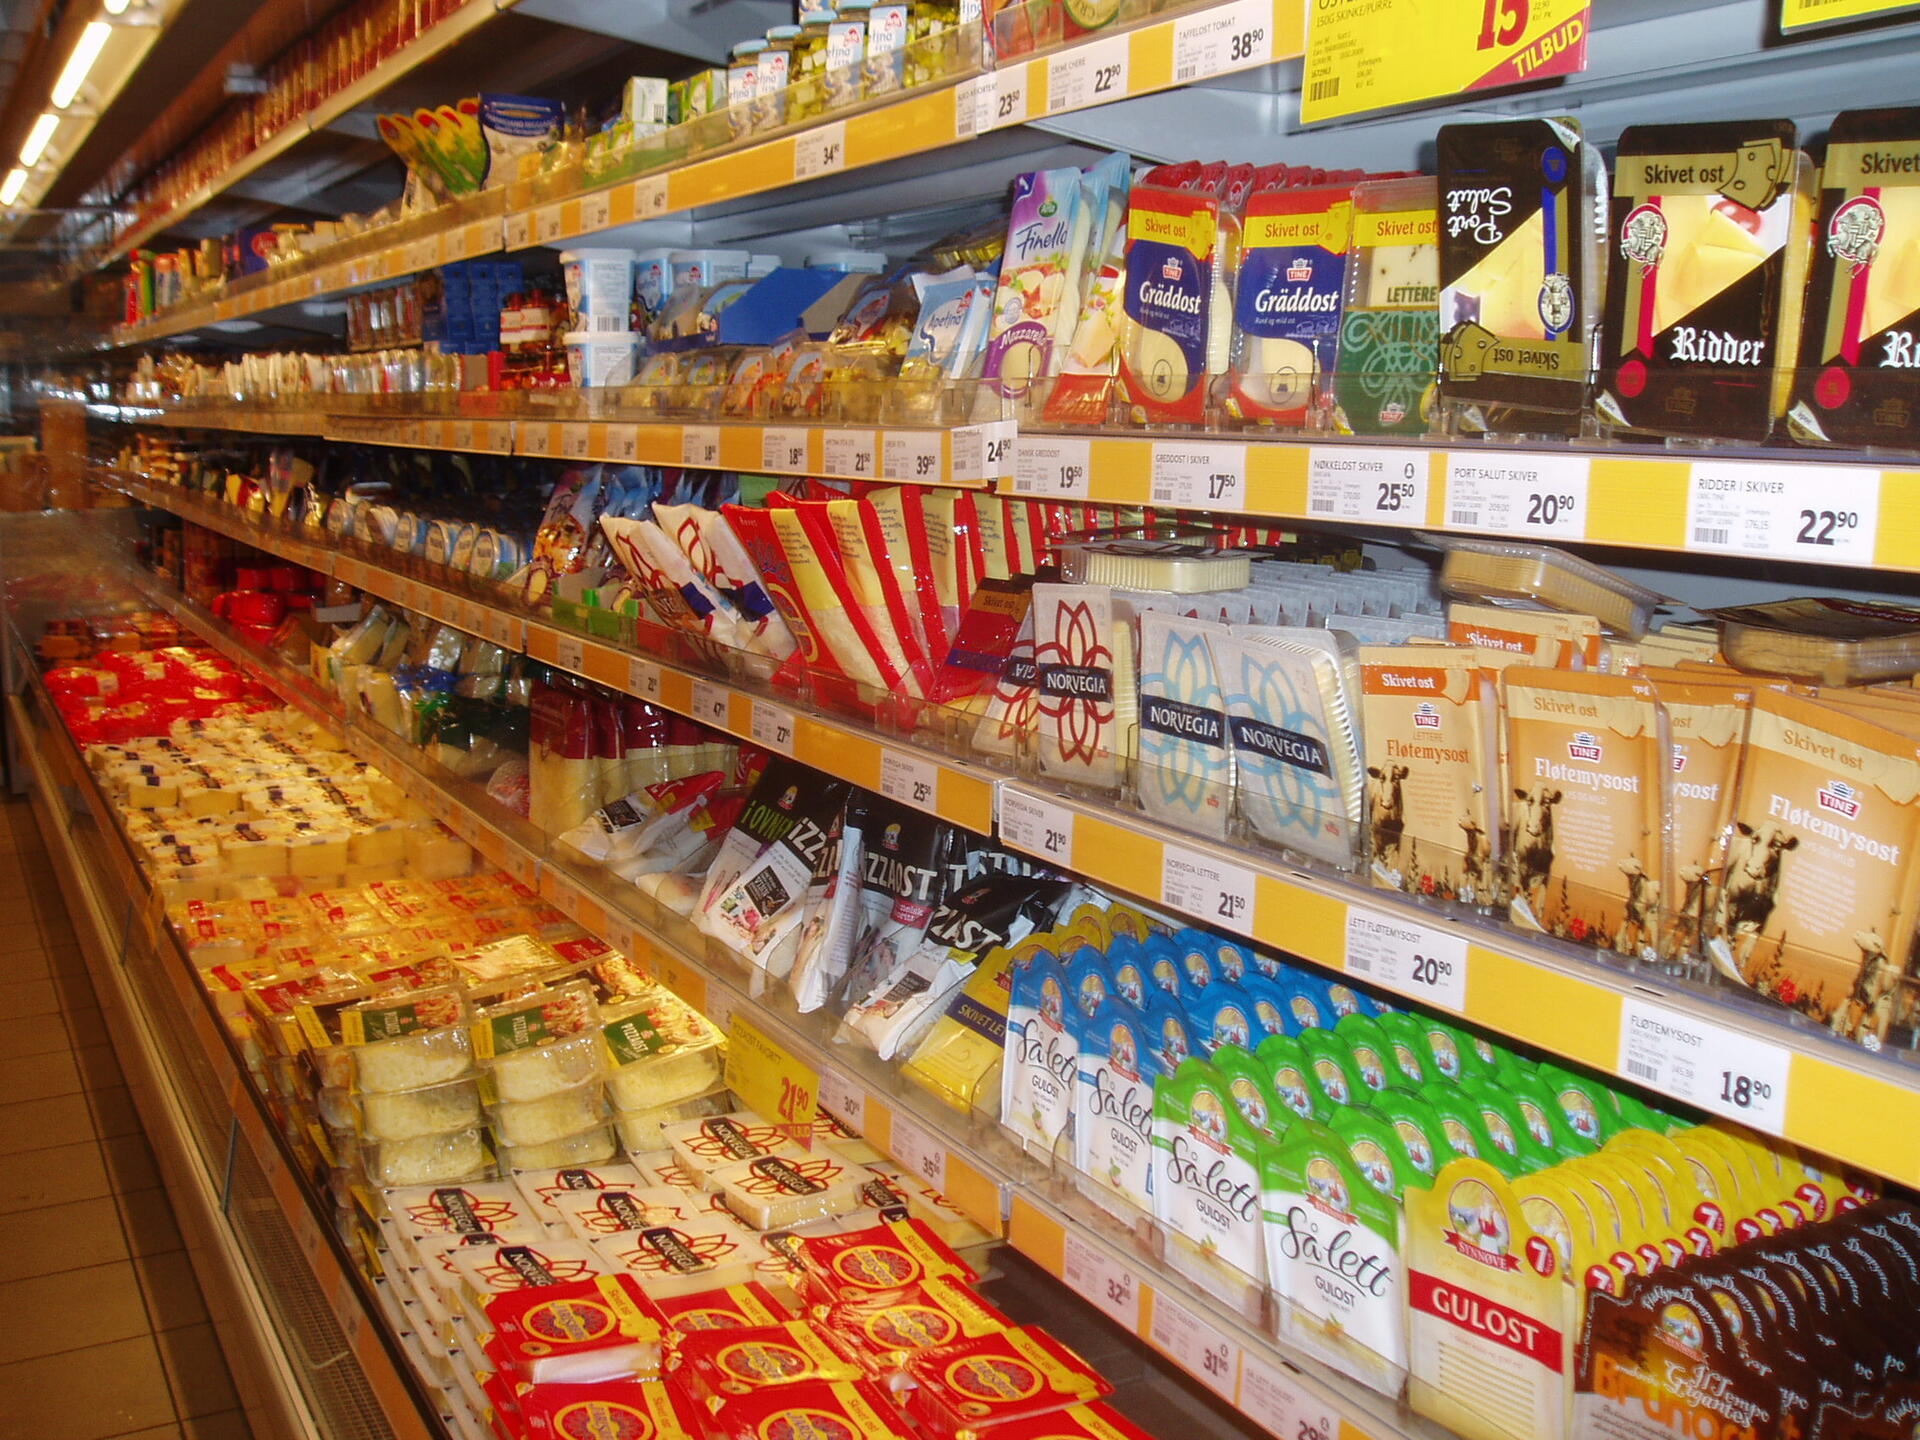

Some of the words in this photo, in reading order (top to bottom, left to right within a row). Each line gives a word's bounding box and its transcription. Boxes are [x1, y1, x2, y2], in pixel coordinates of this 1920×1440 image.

[1212, 17, 1236, 32] TOMAT
[1512, 19, 1583, 78] TILBUD
[1644, 165, 1695, 185] Skivet
[1699, 165, 1725, 184] ost
[1860, 152, 1920, 175] Skivet
[1446, 187, 1513, 216] Salut
[1145, 217, 1170, 235] Skivet
[1172, 221, 1187, 238] ost
[1264, 222, 1296, 240] Skivet
[1298, 222, 1320, 237] ost
[1376, 219, 1417, 237] Skivet
[1418, 218, 1438, 235] ost
[1449, 212, 1503, 245] Port
[1163, 268, 1181, 279] TINE
[1289, 268, 1310, 280] TINE
[1139, 281, 1201, 314] Gräddost
[1254, 285, 1340, 314] Gräddost
[1386, 286, 1438, 304] LETTERE
[1493, 347, 1515, 363] ost
[1669, 326, 1766, 367] Ridder
[1518, 352, 1560, 371] Skivet
[1156, 454, 1184, 464] GREDDOST
[1190, 456, 1210, 465] SKIVER
[1313, 460, 1357, 472] NØKKELOST
[1358, 461, 1383, 472] SKIVER
[1454, 468, 1476, 478] PORT
[1478, 469, 1507, 480] SALUT
[1508, 470, 1538, 482] SKIVER
[1698, 478, 1736, 492] RIDDER
[1745, 480, 1784, 494] SKIVER
[1376, 483, 1414, 511] 2550
[1526, 494, 1574, 525] 2090
[1796, 509, 1858, 546] 2290
[1045, 671, 1107, 698] NORVEGIA
[1382, 674, 1417, 688] Skivet
[1418, 676, 1435, 689] ost
[1534, 696, 1577, 715] Skivet
[1579, 704, 1599, 718] ost
[1150, 704, 1220, 739] NORVEGIA
[1415, 716, 1438, 726] TINE
[1672, 716, 1692, 729] ost
[1240, 725, 1323, 767] NORVEGIA
[1413, 731, 1445, 742] LETTERE
[1387, 739, 1471, 765] Fløtemysost
[1571, 747, 1599, 760] TINE
[1783, 729, 1836, 761] Skivet
[1840, 753, 1865, 772] ost
[1535, 757, 1641, 793] Fløtemysost
[1821, 793, 1856, 814] TINE
[1768, 794, 1901, 866] Fløtemysost
[1166, 858, 1196, 876] NORVEGIA
[1197, 867, 1221, 882] LETTERE
[1350, 917, 1367, 930] LETT
[1368, 920, 1422, 945] FLØTEMYSOST
[1412, 954, 1452, 986] 2090
[958, 1004, 993, 1028] SKIVET
[1631, 1014, 1704, 1048] FLØTEMYSOST
[1032, 1074, 1060, 1099] GULOST
[1719, 1070, 1772, 1109] 1890
[712, 1123, 757, 1160] NORVEGIA
[1111, 1127, 1139, 1153] GULOST
[762, 1161, 814, 1195] NORVEGIA
[1196, 1199, 1231, 1230] GULOST
[510, 1253, 553, 1286] NORVEG
[1529, 1243, 1549, 1273] 7
[1315, 1275, 1356, 1307] GULOST
[1432, 1286, 1541, 1351] GULOST
